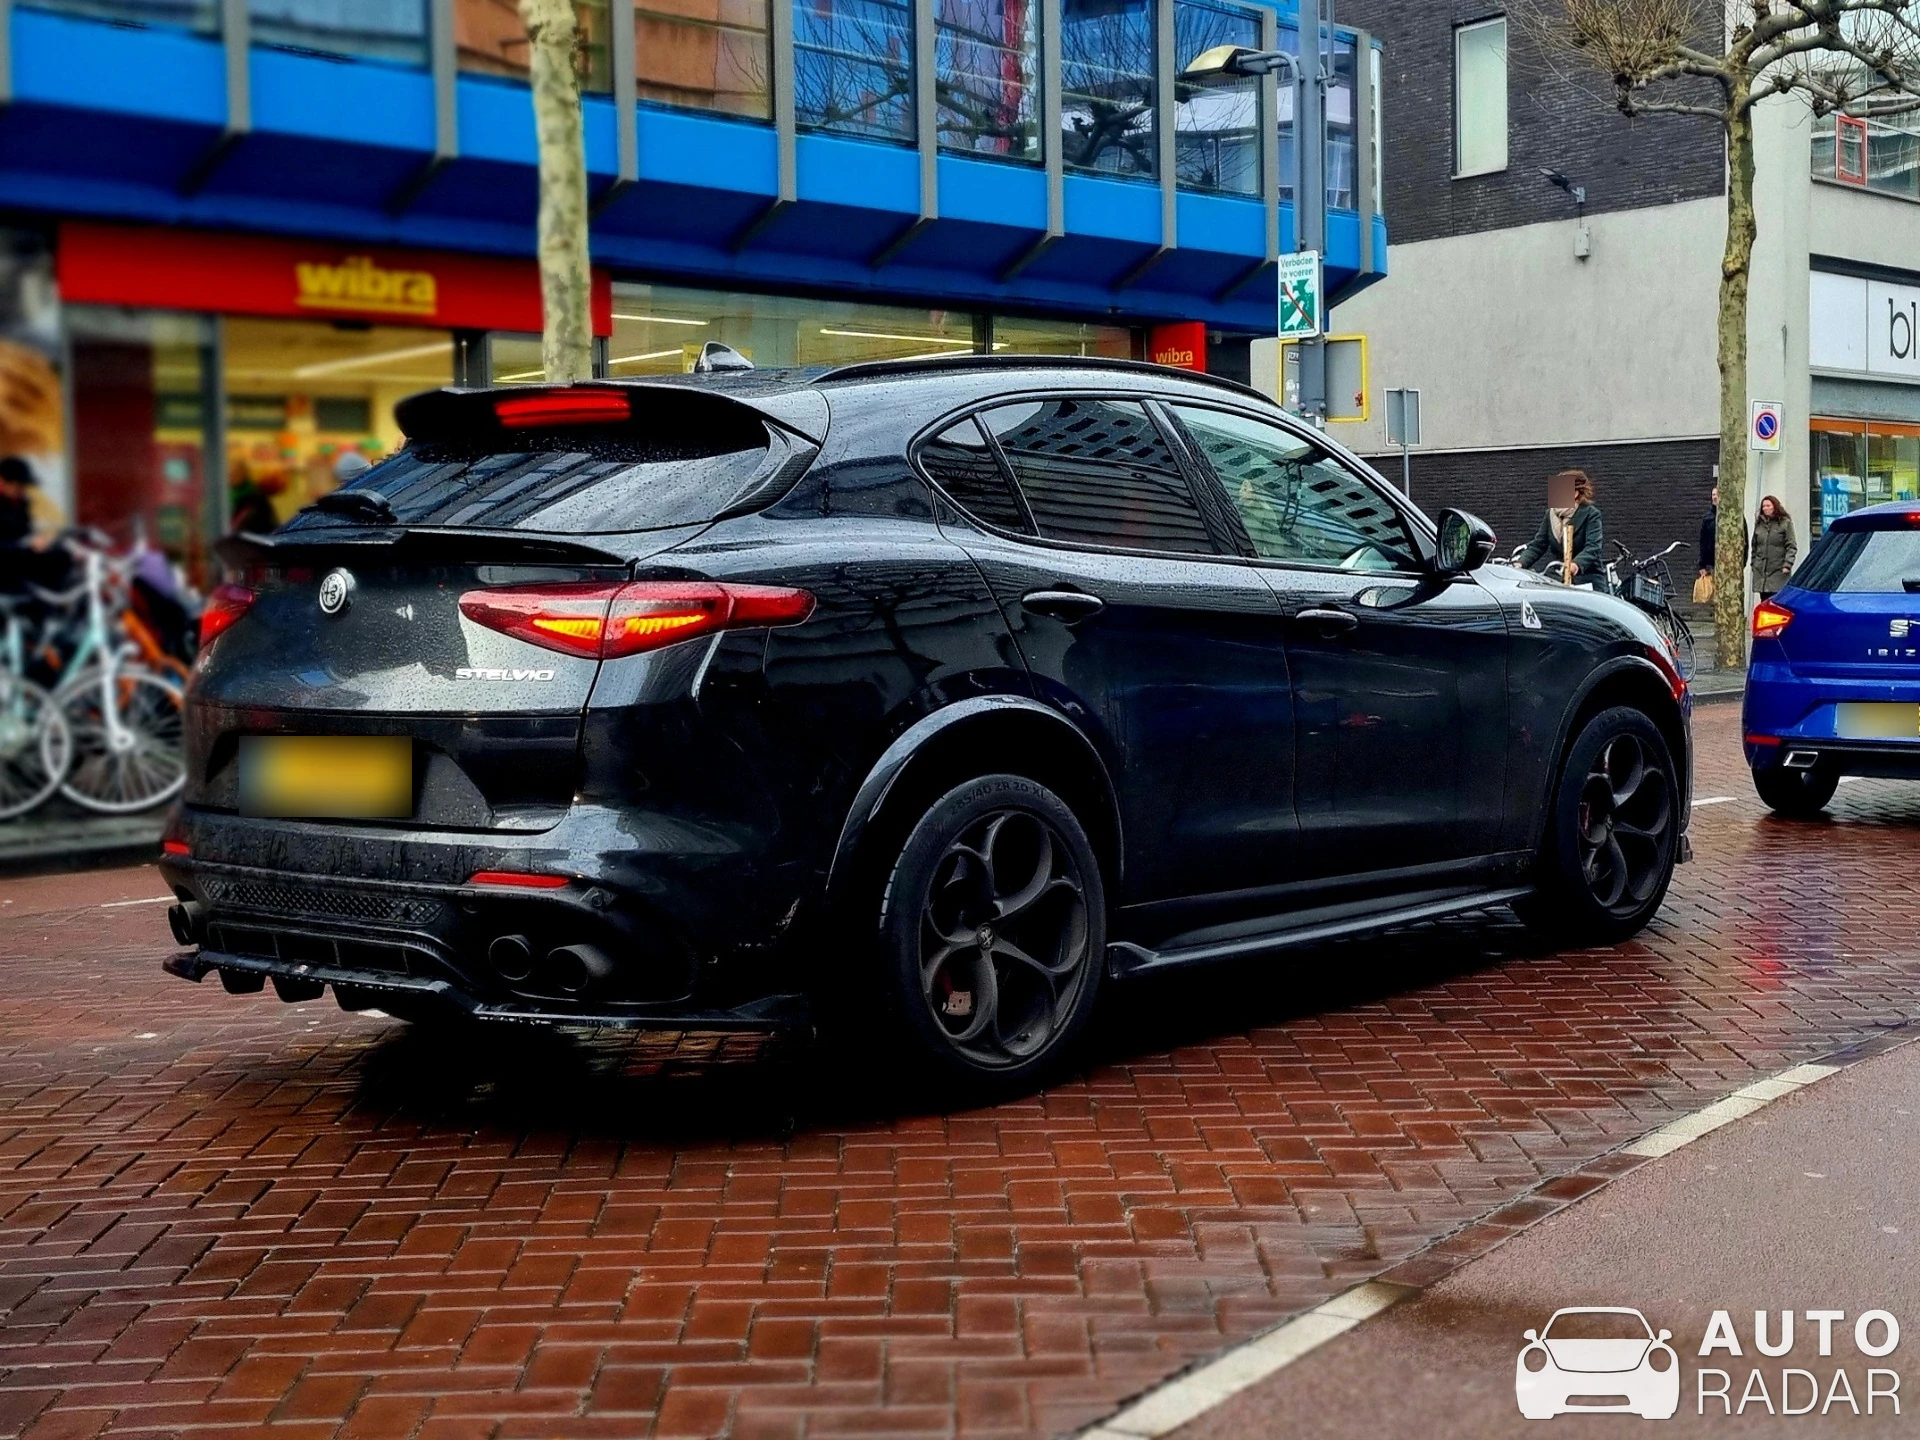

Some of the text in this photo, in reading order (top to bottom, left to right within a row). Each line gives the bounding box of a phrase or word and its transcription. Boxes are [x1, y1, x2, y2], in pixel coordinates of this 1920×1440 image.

[1280, 257, 1314, 268] Verboden
[296, 255, 437, 308] wibra
[1155, 347, 1193, 364] wibra
[455, 668, 556, 682] STELVIO
[1013, 781, 1029, 792] 20
